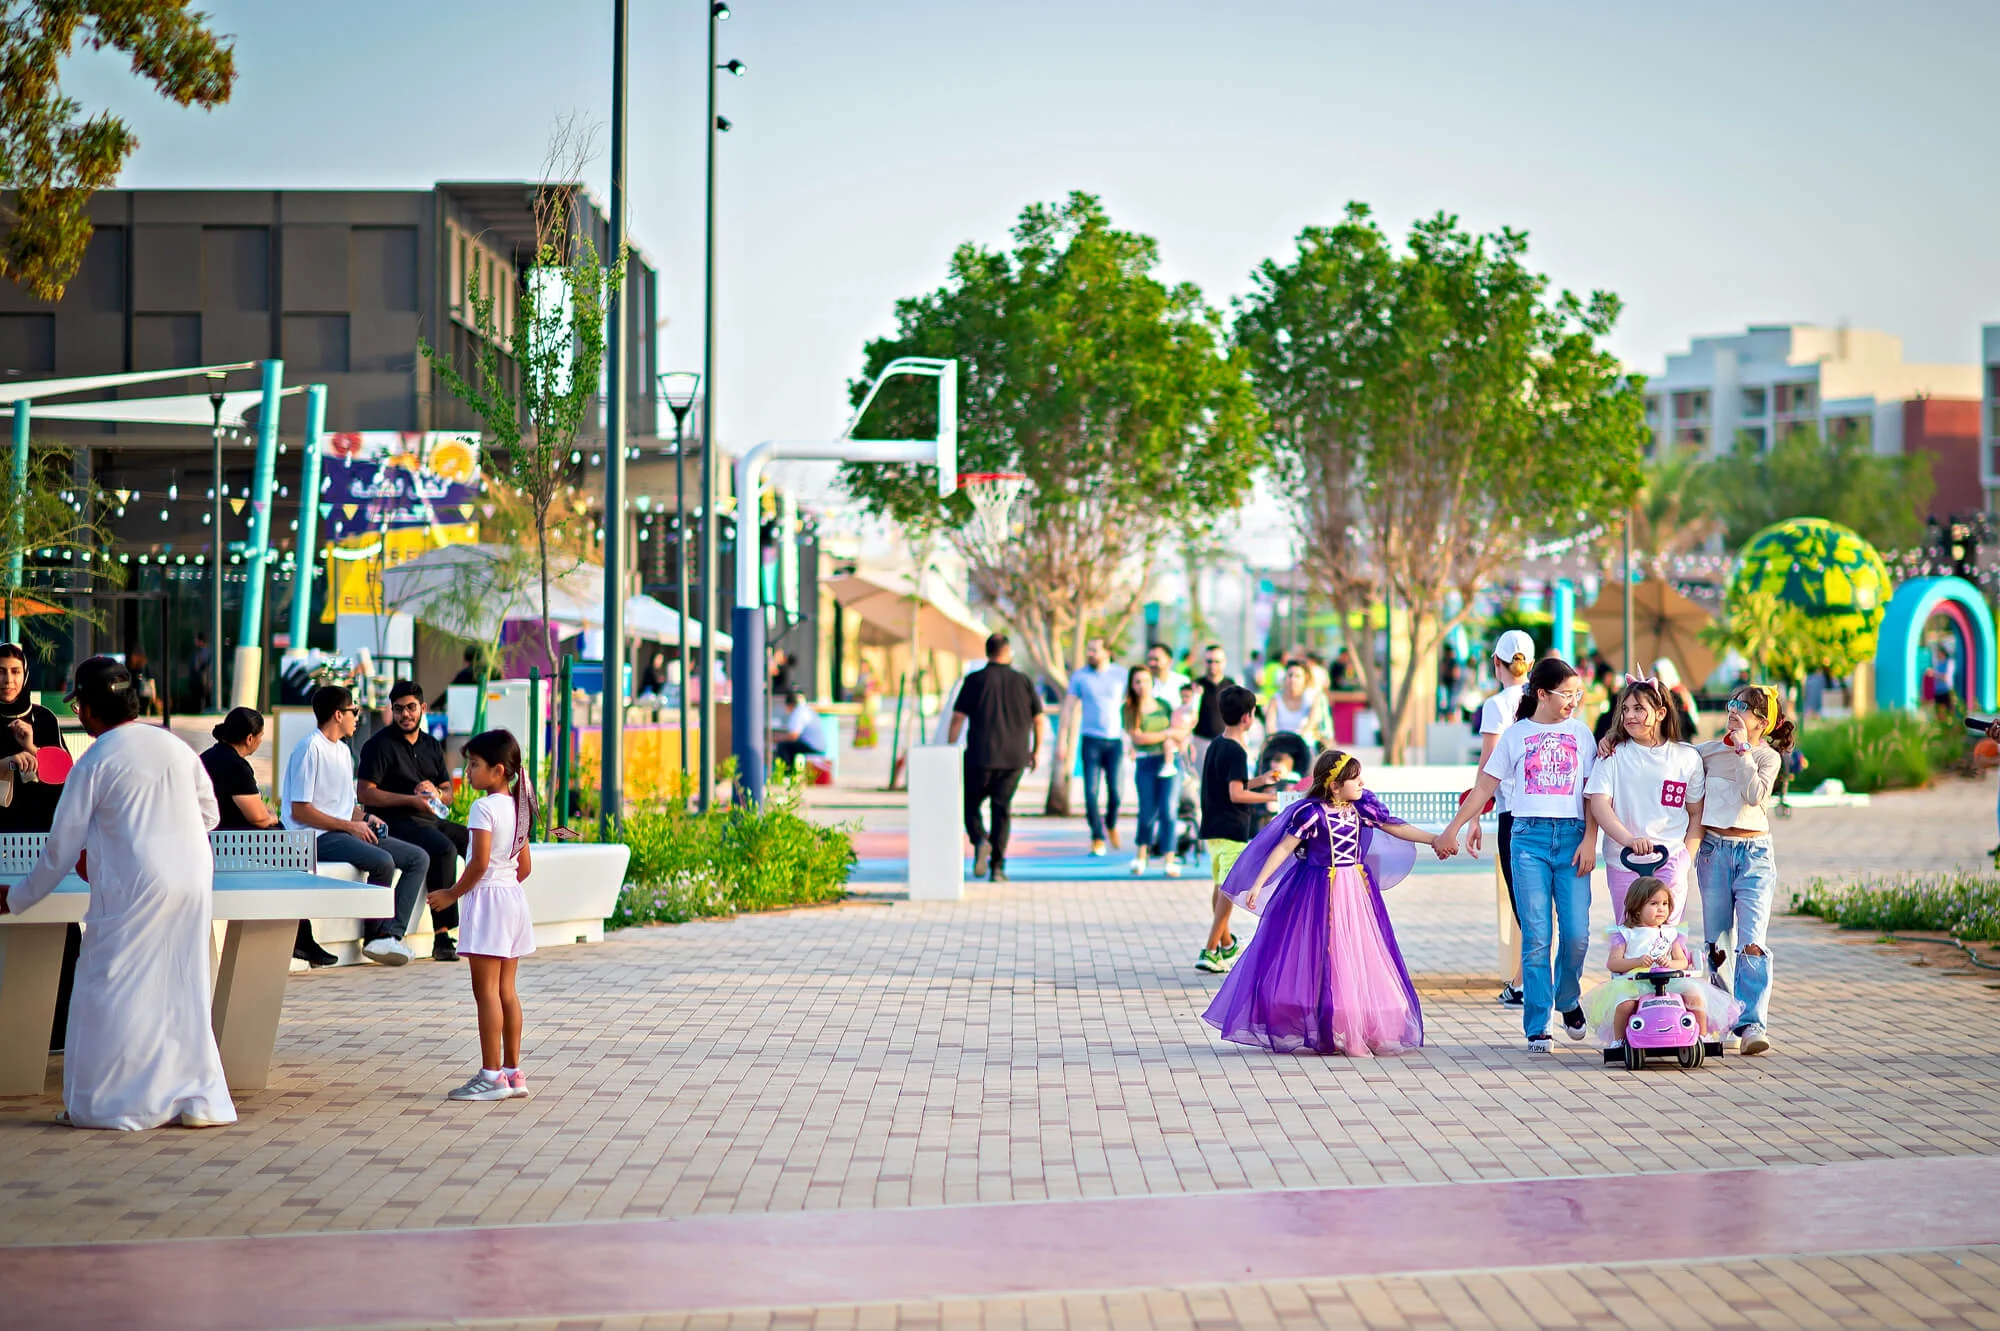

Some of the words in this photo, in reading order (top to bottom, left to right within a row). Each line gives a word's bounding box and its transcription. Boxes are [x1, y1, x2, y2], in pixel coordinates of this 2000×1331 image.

[1540, 749, 1566, 762] WITH
[1542, 761, 1561, 773] THE
[1538, 773, 1566, 786] FLOW
